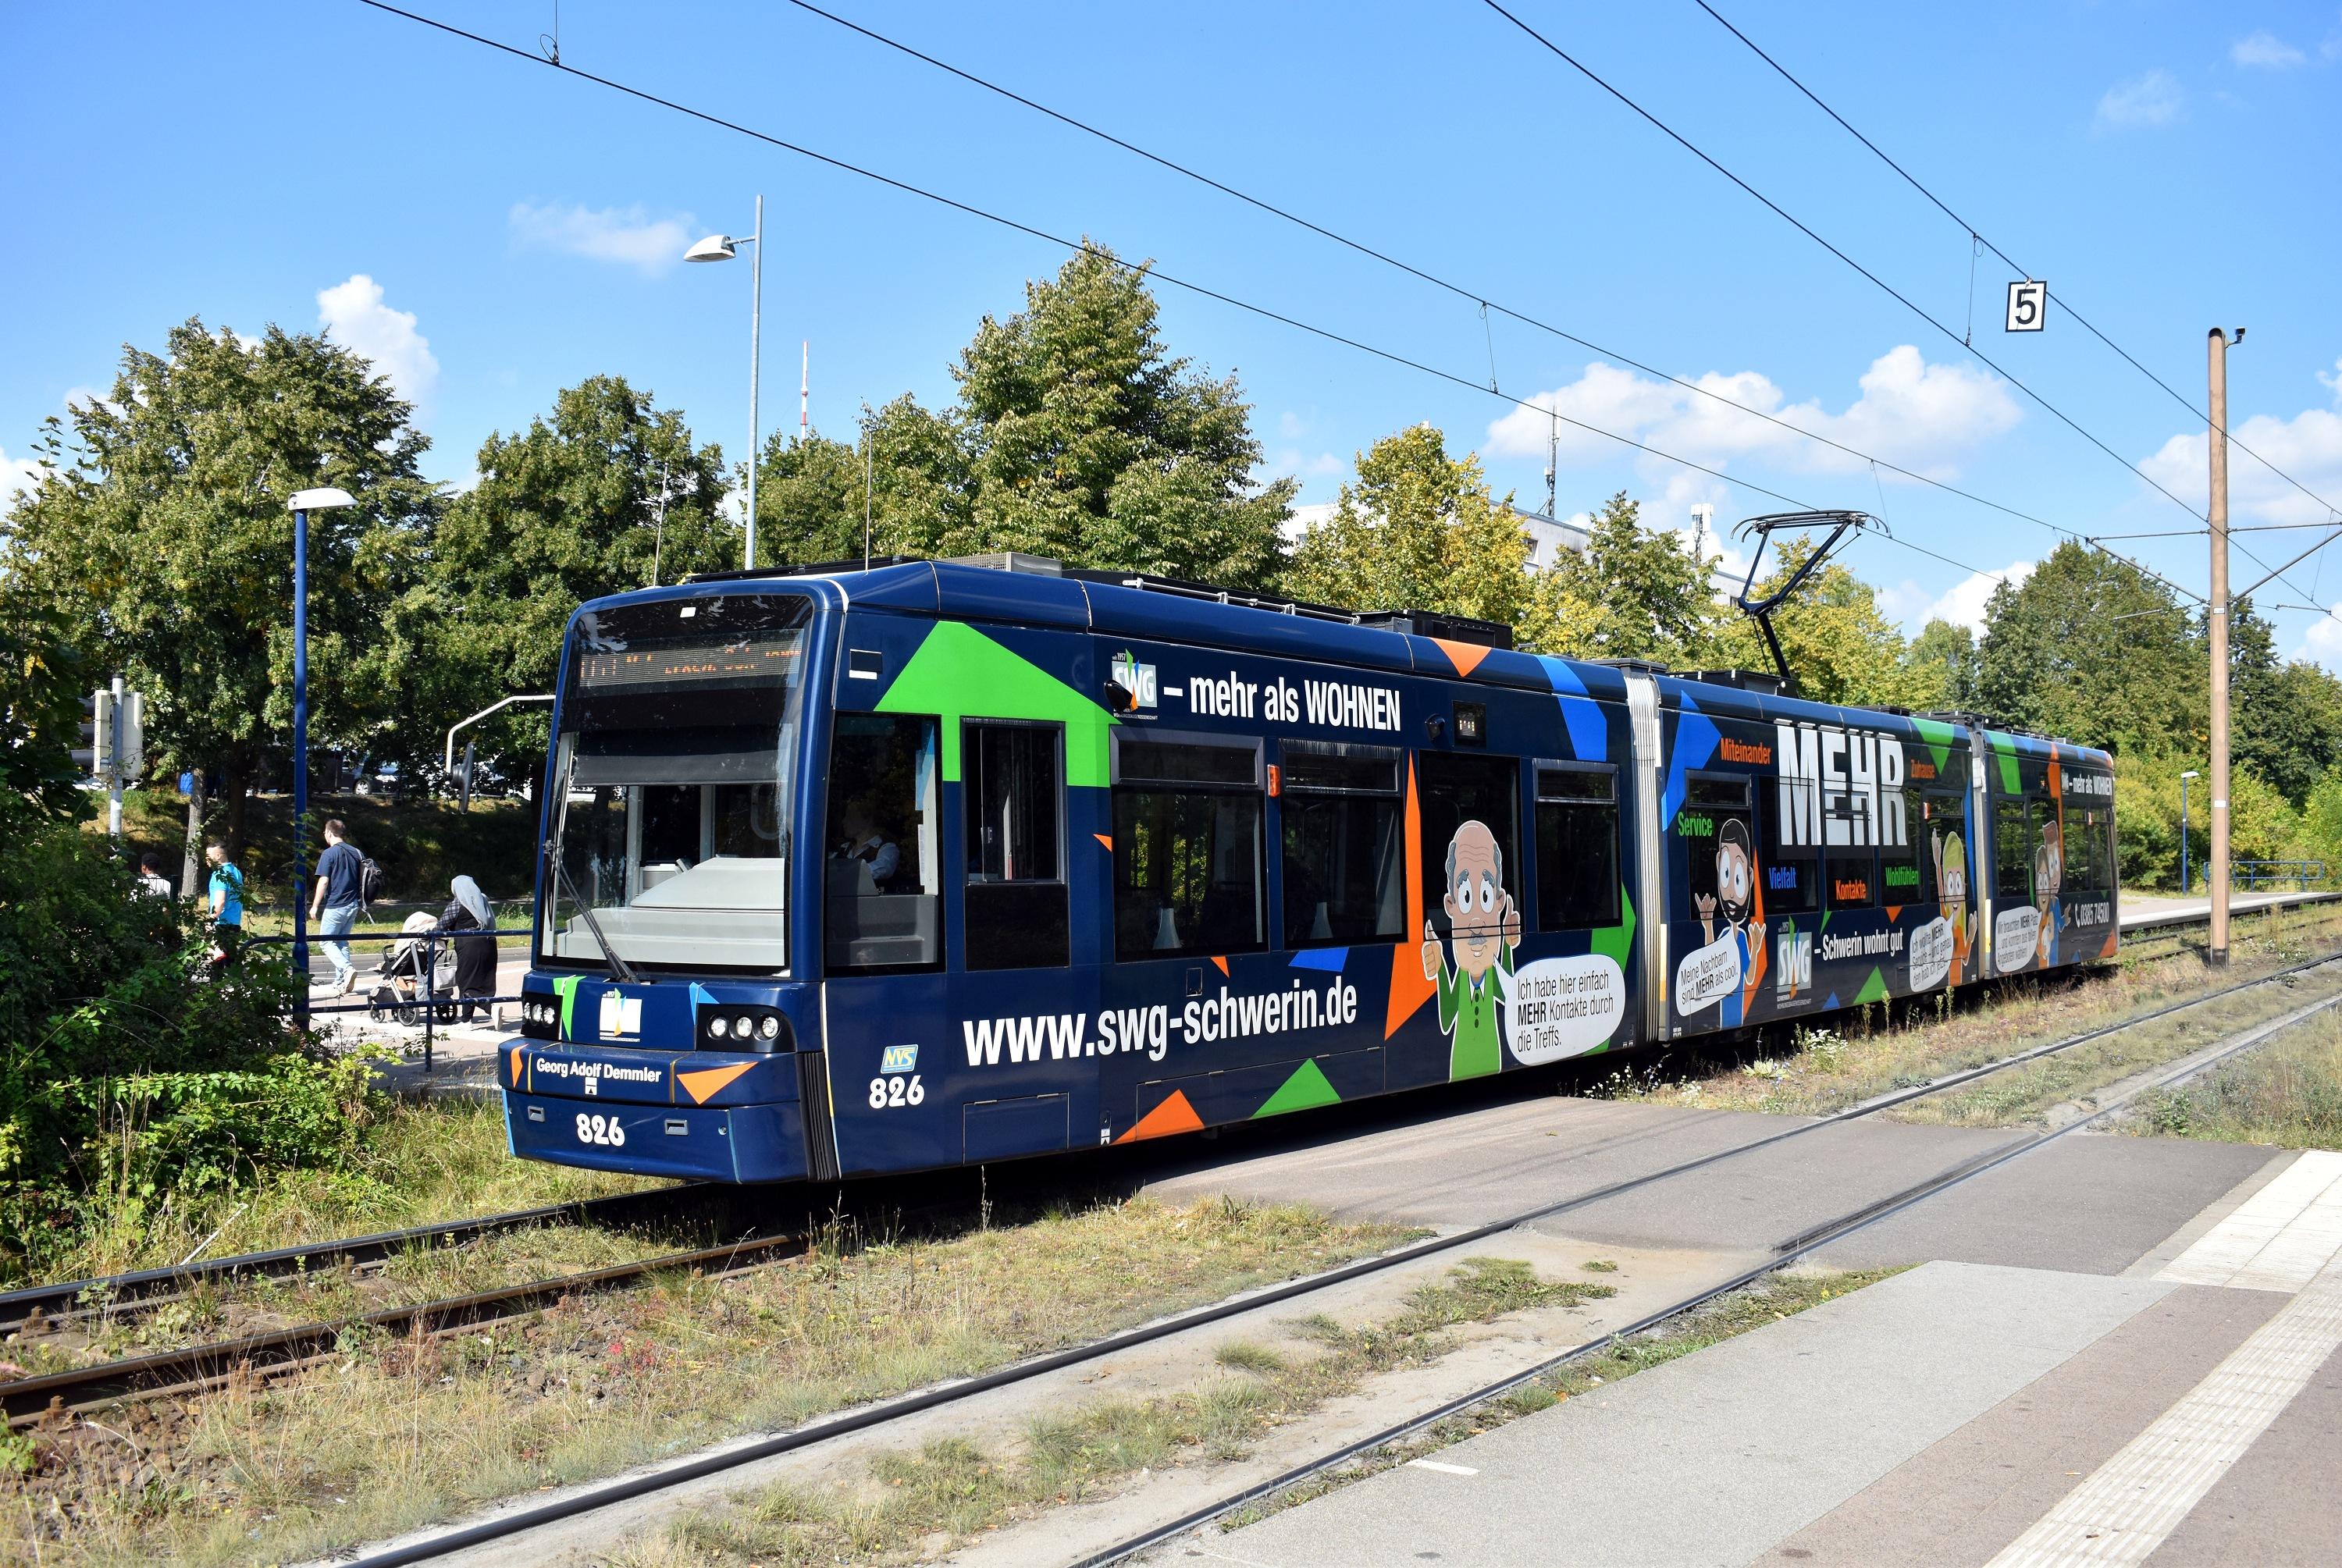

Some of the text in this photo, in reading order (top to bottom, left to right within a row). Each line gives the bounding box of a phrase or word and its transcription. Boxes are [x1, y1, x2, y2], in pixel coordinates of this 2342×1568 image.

[2015, 288, 2037, 325] 5
[1117, 652, 1126, 661] 1957
[1190, 670, 1258, 719] mehr
[1265, 677, 1299, 723] als
[1304, 679, 1401, 731] WOHNEN
[1721, 737, 1771, 765] Miteinander
[1774, 718, 1908, 846] MEHR
[1678, 812, 1713, 837] Service
[1768, 866, 1797, 890] Vielfalt
[1835, 879, 1867, 901] Kontakte
[1885, 866, 1919, 887] Wohlfühlen
[1932, 923, 1944, 942] MEHR
[1681, 951, 1728, 987] Meine Nachbarn
[1779, 939, 1810, 987] SWG
[1823, 931, 1863, 962] Schwerin
[1863, 927, 1888, 955] wohnt
[1890, 926, 1903, 958] gut
[1518, 969, 1609, 1001] Ich habe hier einfach
[1682, 961, 1739, 1005] sind MEHR als cool.
[963, 976, 1357, 1066] www.swg-schwerin.de
[1518, 993, 1614, 1026] MEHR Kontakte durch
[1518, 1025, 1562, 1053] die Treffs.
[536, 1058, 662, 1083] Georg Adolf Demmler
[884, 1047, 916, 1066] NVS
[869, 1075, 925, 1109] 826
[576, 1113, 625, 1147] 826
